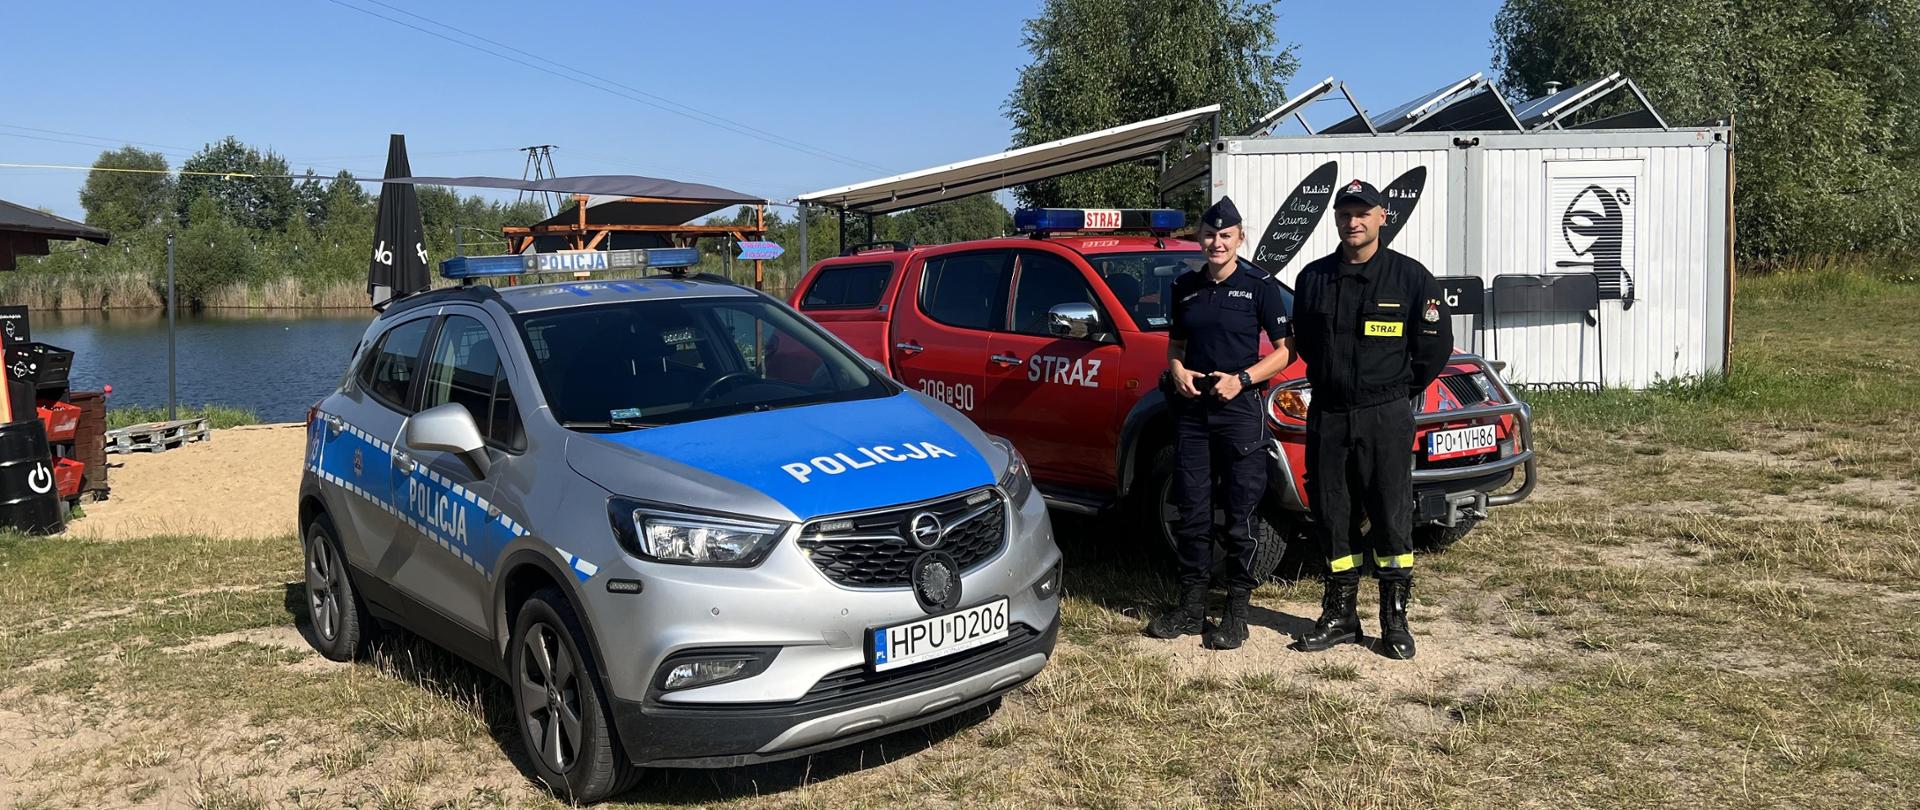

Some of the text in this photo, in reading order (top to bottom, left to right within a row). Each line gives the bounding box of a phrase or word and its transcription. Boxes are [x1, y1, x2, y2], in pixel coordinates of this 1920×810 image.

[1278, 211, 1310, 226] Sauna
[540, 253, 606, 270] POLICJA
[1256, 245, 1268, 262] &
[1228, 290, 1253, 300] POLICJA
[1027, 354, 1102, 388] STRAŻ
[1457, 426, 1494, 450] 1VH86
[780, 441, 957, 484] POLICJA
[408, 476, 468, 546] POLICJA
[891, 618, 945, 658] HPU
[953, 602, 1004, 643] D206
[876, 650, 886, 660] PL
